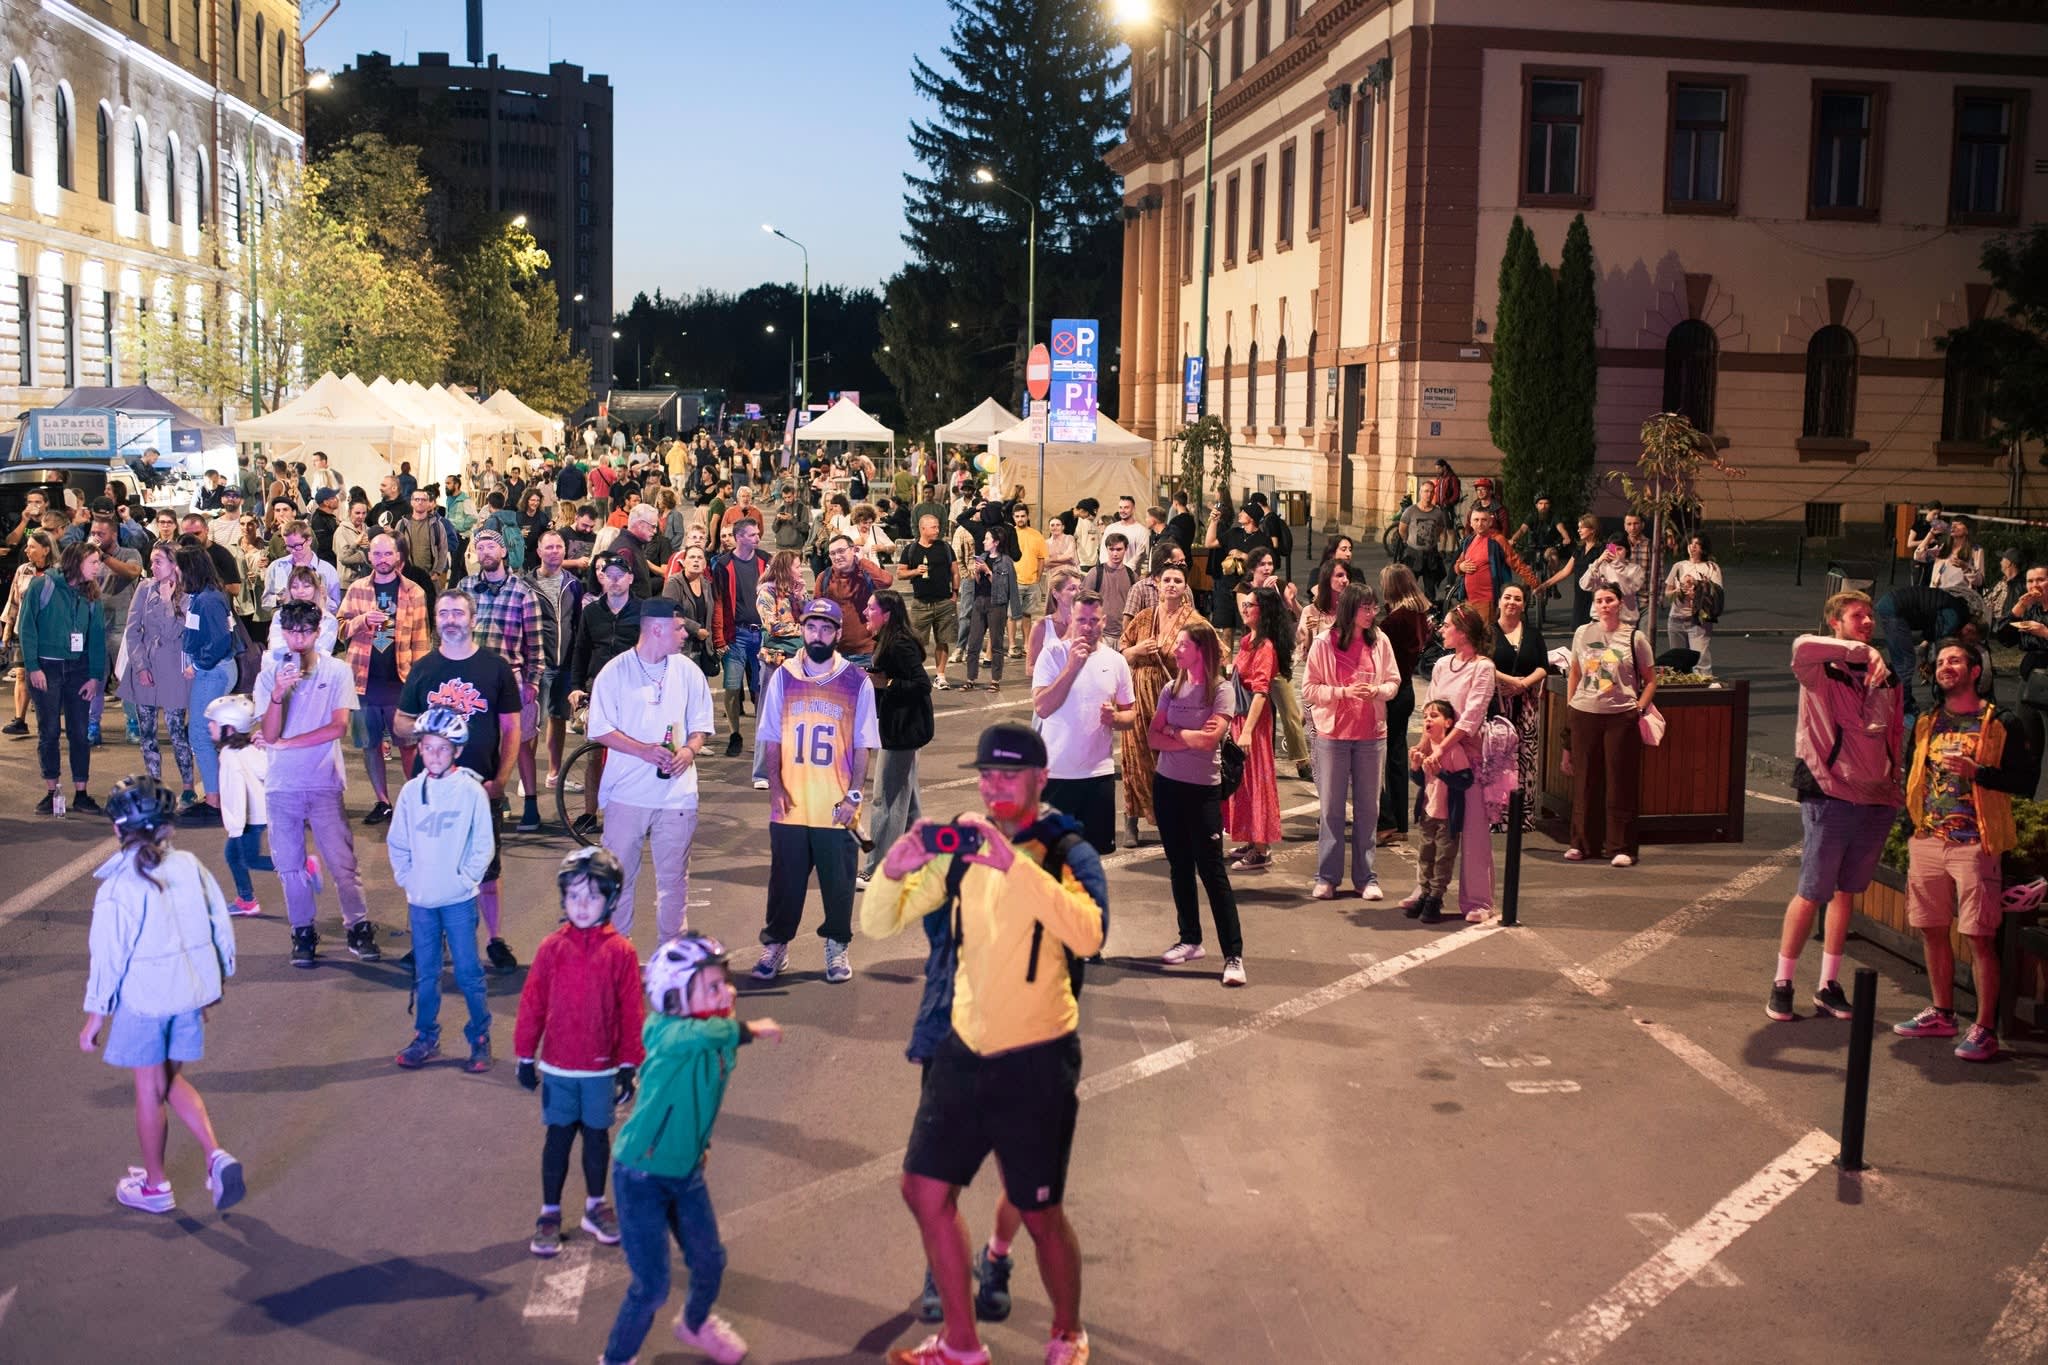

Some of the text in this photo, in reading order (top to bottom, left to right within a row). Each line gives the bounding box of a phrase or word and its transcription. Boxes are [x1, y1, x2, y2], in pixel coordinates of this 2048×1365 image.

[1076, 327, 1095, 357] P
[1190, 360, 1199, 384] P
[1065, 383, 1083, 409] P
[44, 432, 80, 447] ON TOUR
[793, 721, 837, 767] 16
[415, 810, 461, 838] 4F
